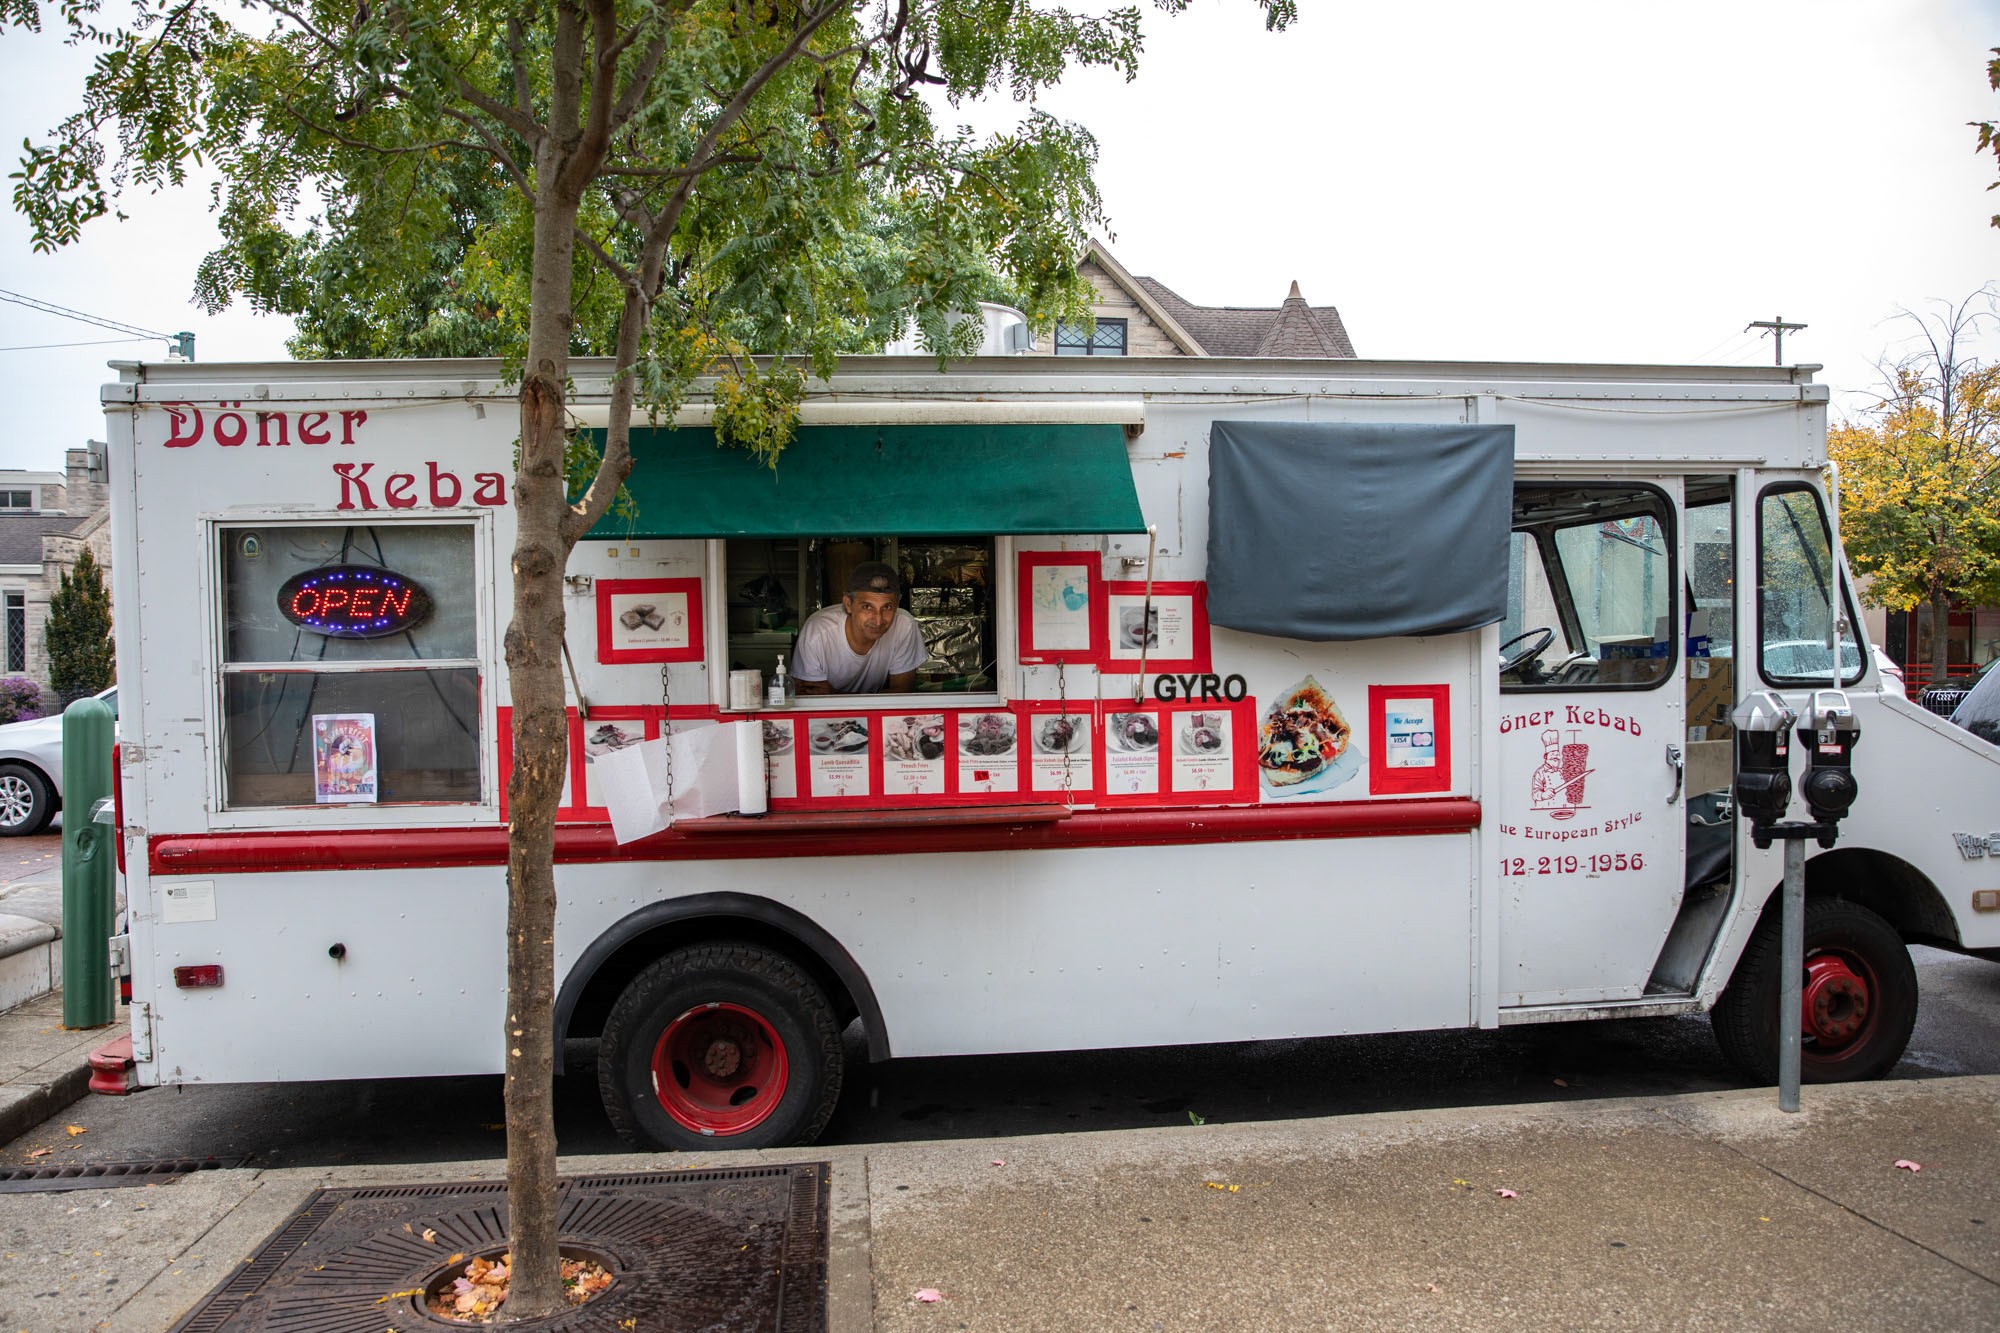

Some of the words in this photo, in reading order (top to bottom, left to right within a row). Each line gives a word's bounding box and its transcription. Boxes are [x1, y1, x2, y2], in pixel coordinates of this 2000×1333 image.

[160, 401, 368, 448] Döner
[333, 462, 508, 510] Keba
[293, 589, 412, 618] OPEN
[1153, 673, 1248, 704] GYRO
[1393, 717, 1403, 725] We
[1404, 717, 1423, 725] Accept
[1500, 711, 1554, 733] öner
[1565, 705, 1642, 737] Kebab
[1499, 823, 1517, 836] ue
[1524, 826, 1598, 842] European
[1604, 811, 1642, 833] Style
[1952, 832, 1990, 849] Value
[1500, 853, 1643, 877] 12-219-1956
[1957, 845, 1985, 861] Van
